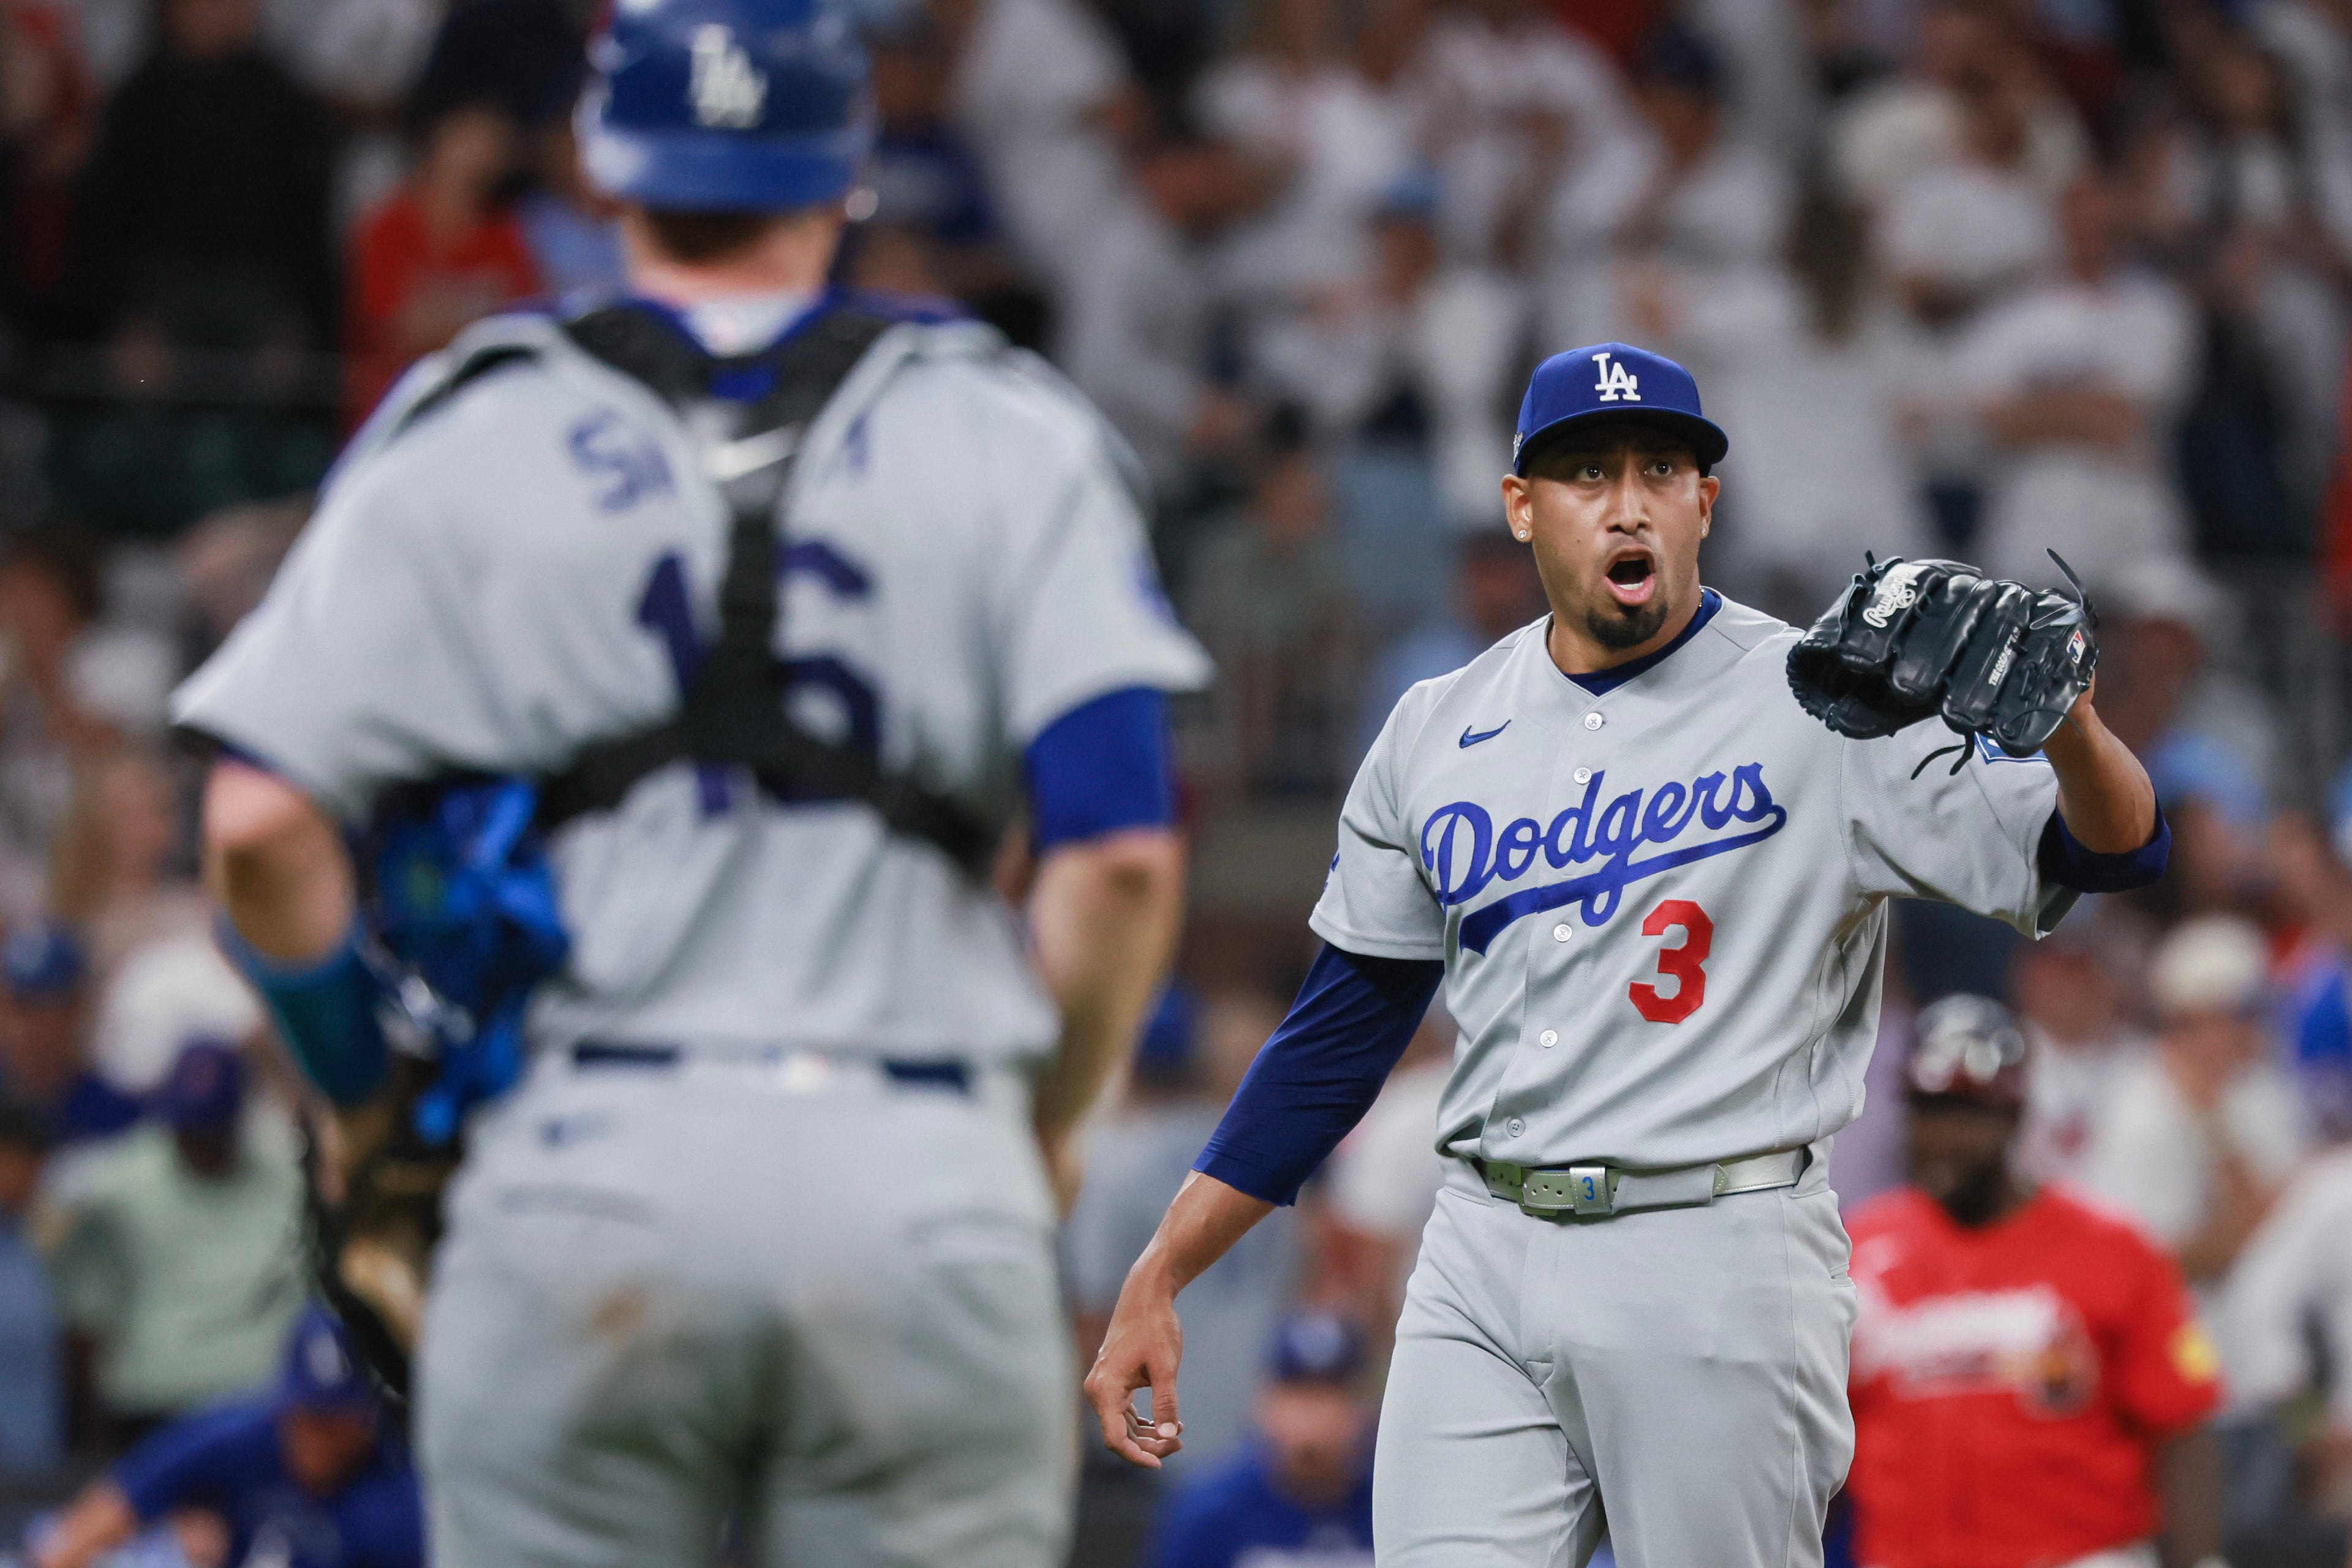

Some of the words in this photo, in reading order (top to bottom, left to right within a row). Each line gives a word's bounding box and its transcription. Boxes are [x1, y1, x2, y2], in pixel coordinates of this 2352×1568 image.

[1592, 352, 1642, 402] LA
[1988, 668, 2001, 686] THE
[1420, 761, 1776, 927] Dodgers
[1629, 899, 1714, 1024] 3
[1582, 1176, 1596, 1201] 3
